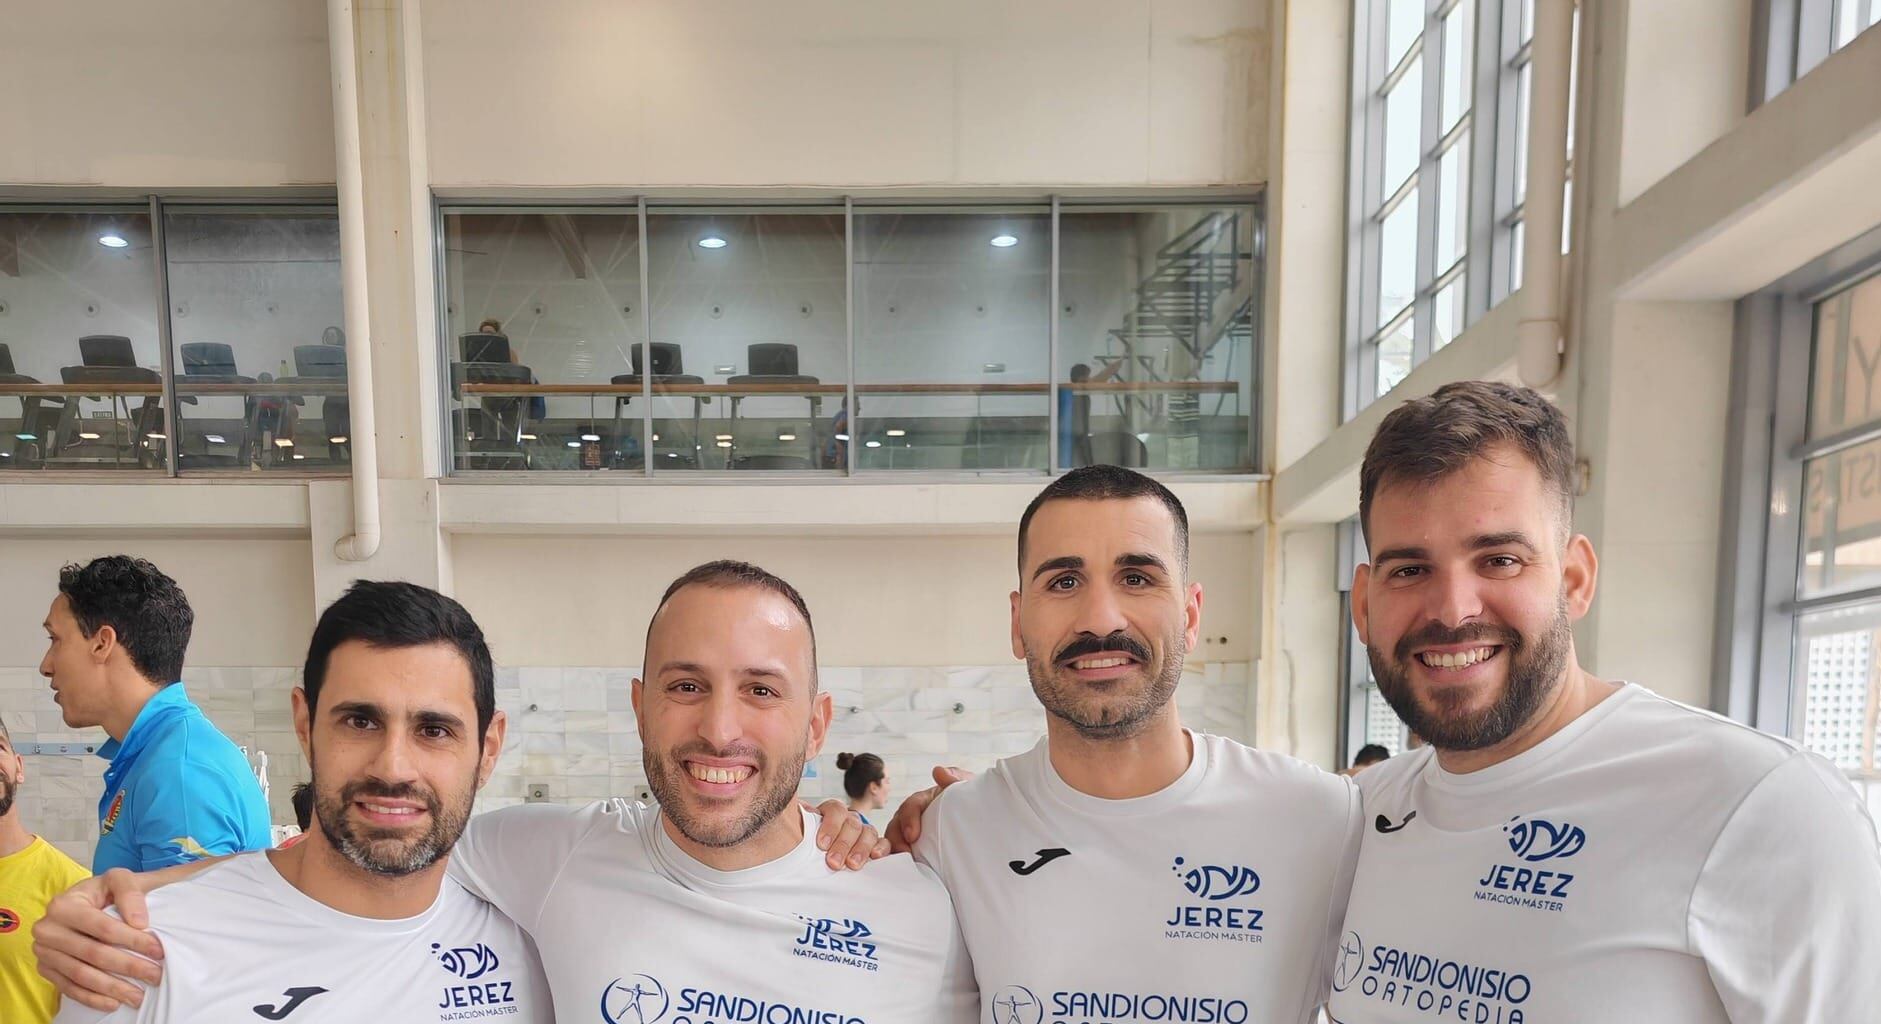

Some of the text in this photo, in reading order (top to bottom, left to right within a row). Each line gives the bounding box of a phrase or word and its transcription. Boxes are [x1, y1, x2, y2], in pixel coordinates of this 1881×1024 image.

[1480, 864, 1574, 898] JEREZ
[1166, 906, 1263, 931] JEREZ
[796, 925, 878, 960] JEREZ
[1368, 946, 1531, 1004] SANDIONISIO
[439, 981, 514, 1009] JEREZ
[1052, 992, 1248, 1024] SANDIONISIO
